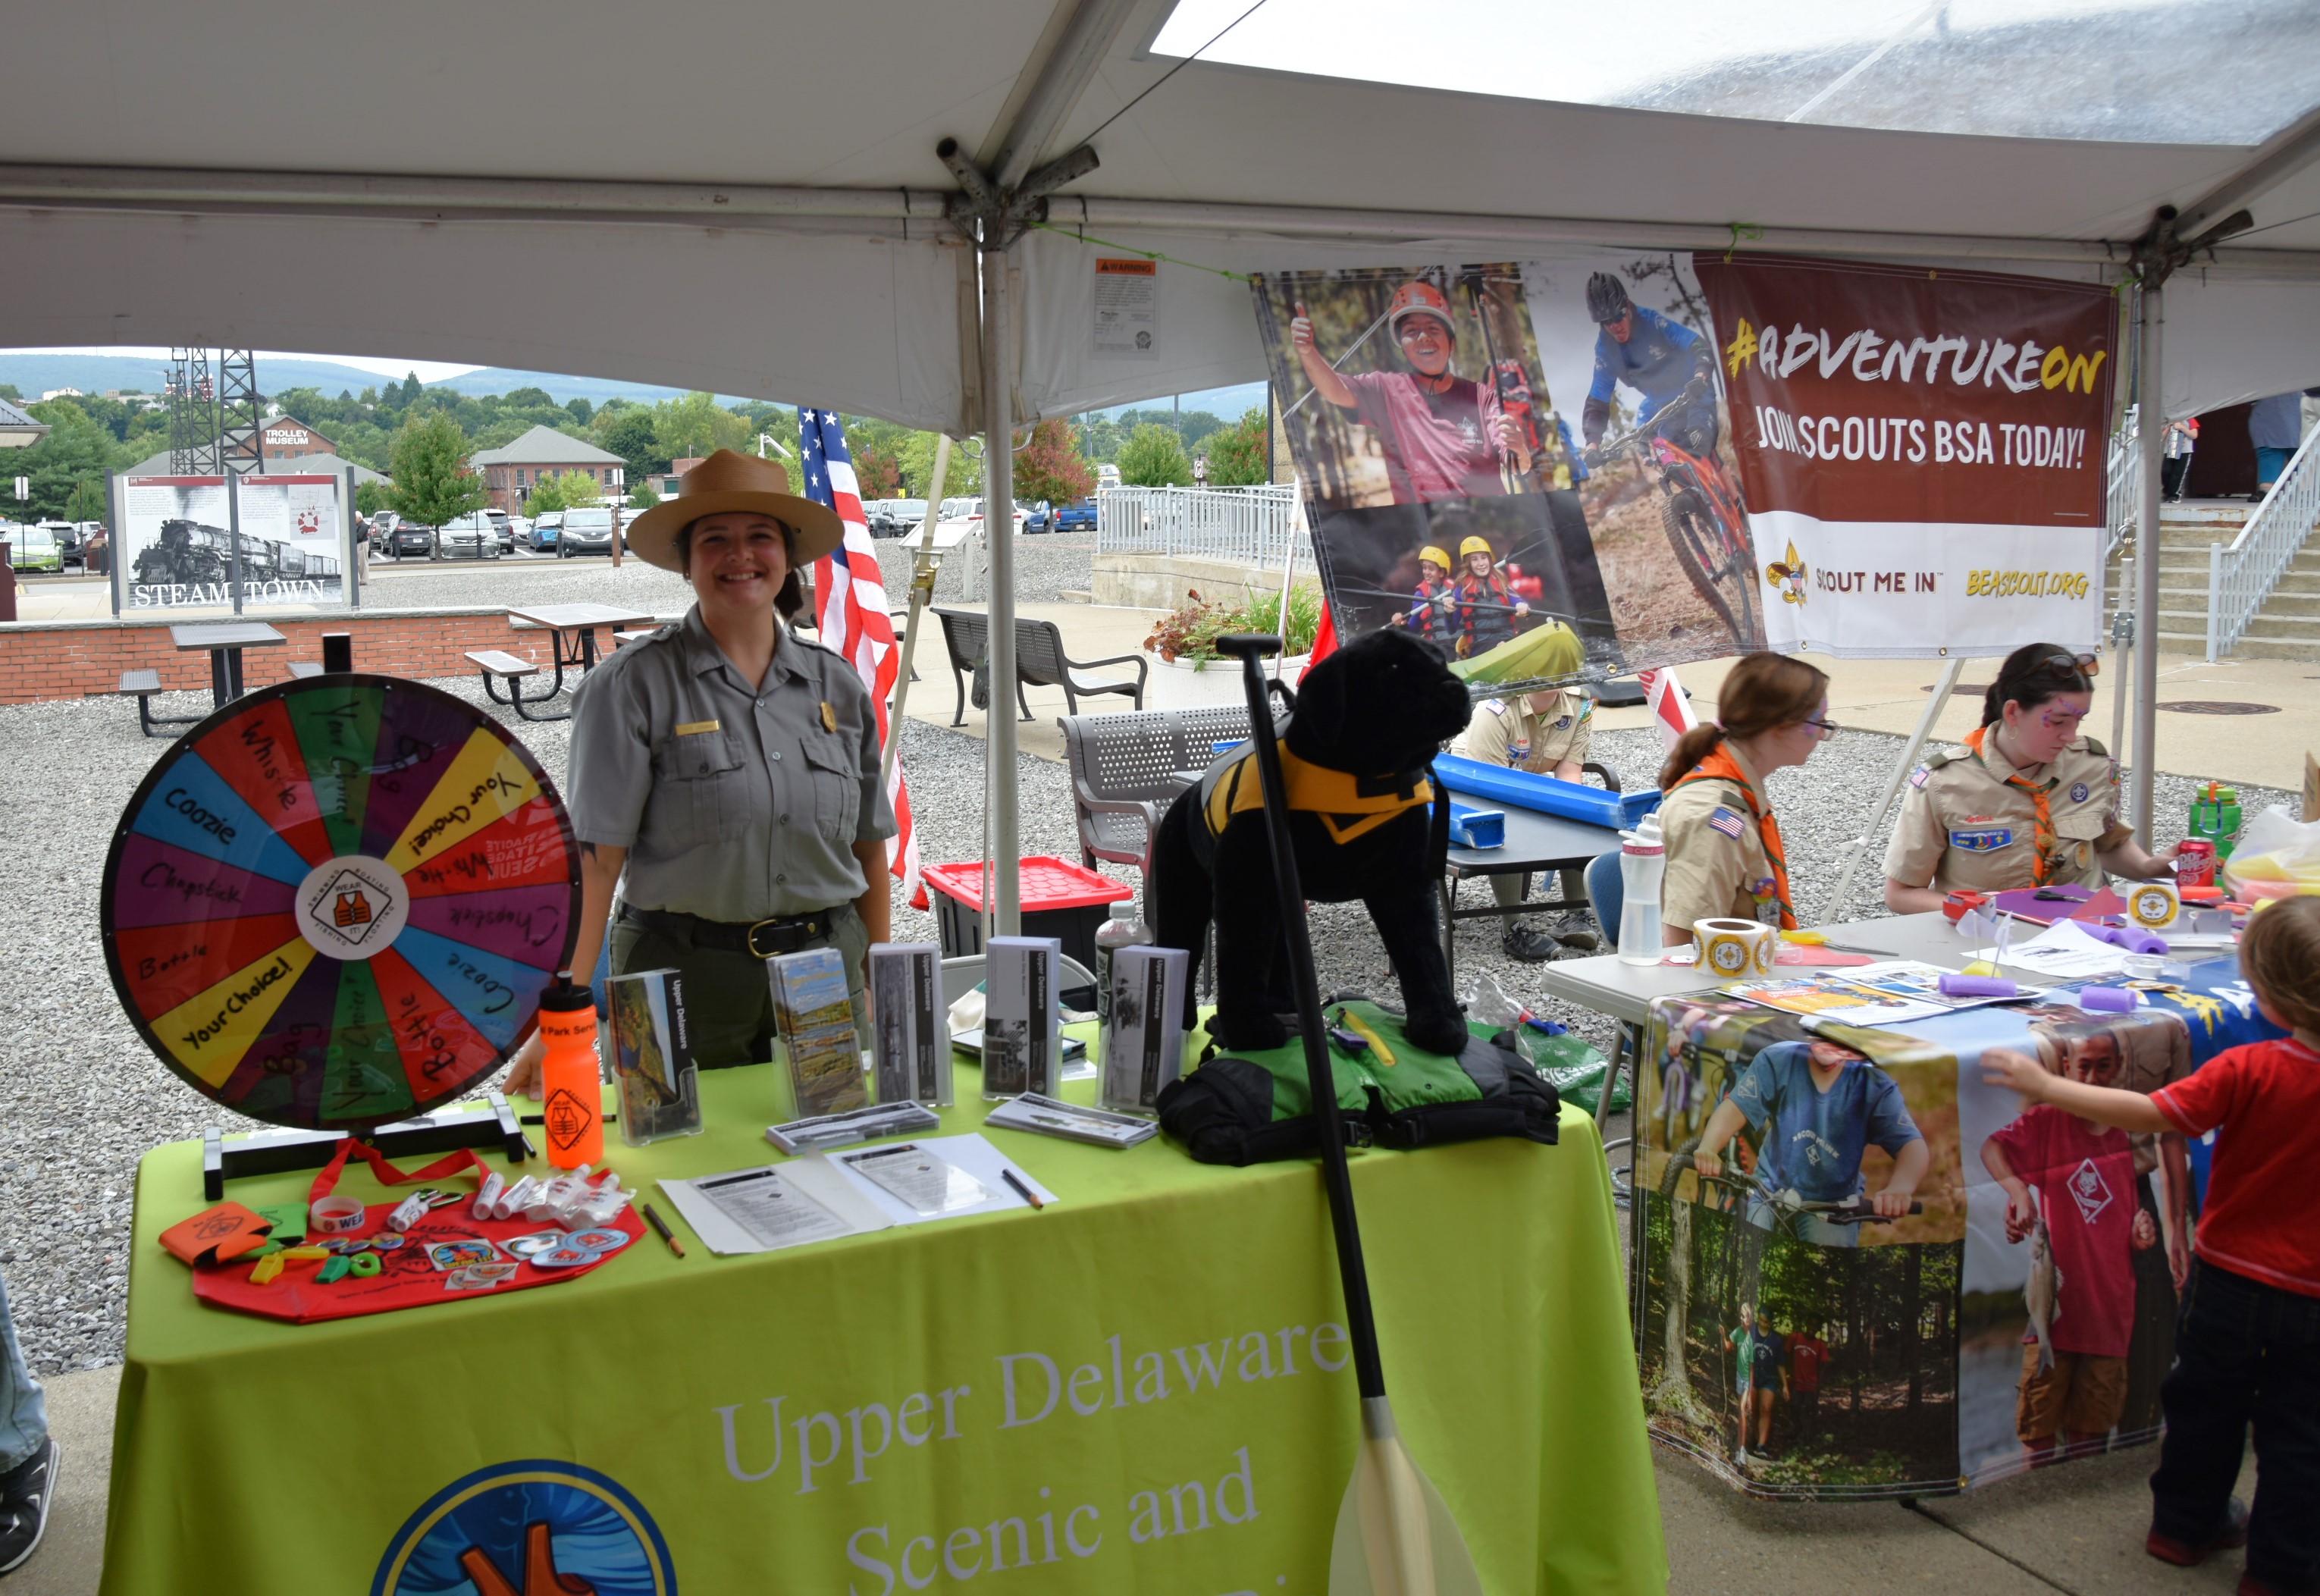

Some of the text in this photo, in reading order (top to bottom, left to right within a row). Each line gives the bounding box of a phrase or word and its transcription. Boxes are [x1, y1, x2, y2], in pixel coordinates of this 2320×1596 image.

[1726, 317, 2106, 394] #ADVENTUREON
[265, 429, 309, 437] TROLLEY
[265, 437, 309, 445] MUSEUM
[1754, 406, 2085, 469] JOIN SCOUTS BSA TODAY!
[244, 579, 325, 604] TOWN
[1816, 568, 1865, 594] SCOUT
[1873, 572, 1906, 594] ME
[1966, 570, 2089, 600] BEASCOUT.ORG
[241, 720, 296, 811] Whistle
[377, 735, 435, 794] Bag
[408, 772, 522, 857] Your Choice!
[141, 861, 243, 905] Chapstick
[307, 869, 340, 908] SWIMMING
[334, 882, 362, 892] WEAR
[355, 867, 390, 893] BOATING
[315, 922, 348, 947] FISHING
[349, 926, 361, 935] IT!
[363, 905, 395, 944] FLOATING
[139, 944, 208, 981] Bottle
[1036, 952, 1046, 974] Upper
[182, 956, 293, 1050] Your Choice!
[922, 955, 933, 1012] Upper Delaware
[1154, 959, 1164, 1019] Upper Delaware
[547, 1026, 571, 1036] Park
[673, 979, 688, 1050] Upper Delaware
[262, 1023, 323, 1074] Bag
[399, 992, 456, 1083] Bottle
[710, 1319, 1350, 1495] Upper Delaware
[845, 1445, 1262, 1596] Scenic and
